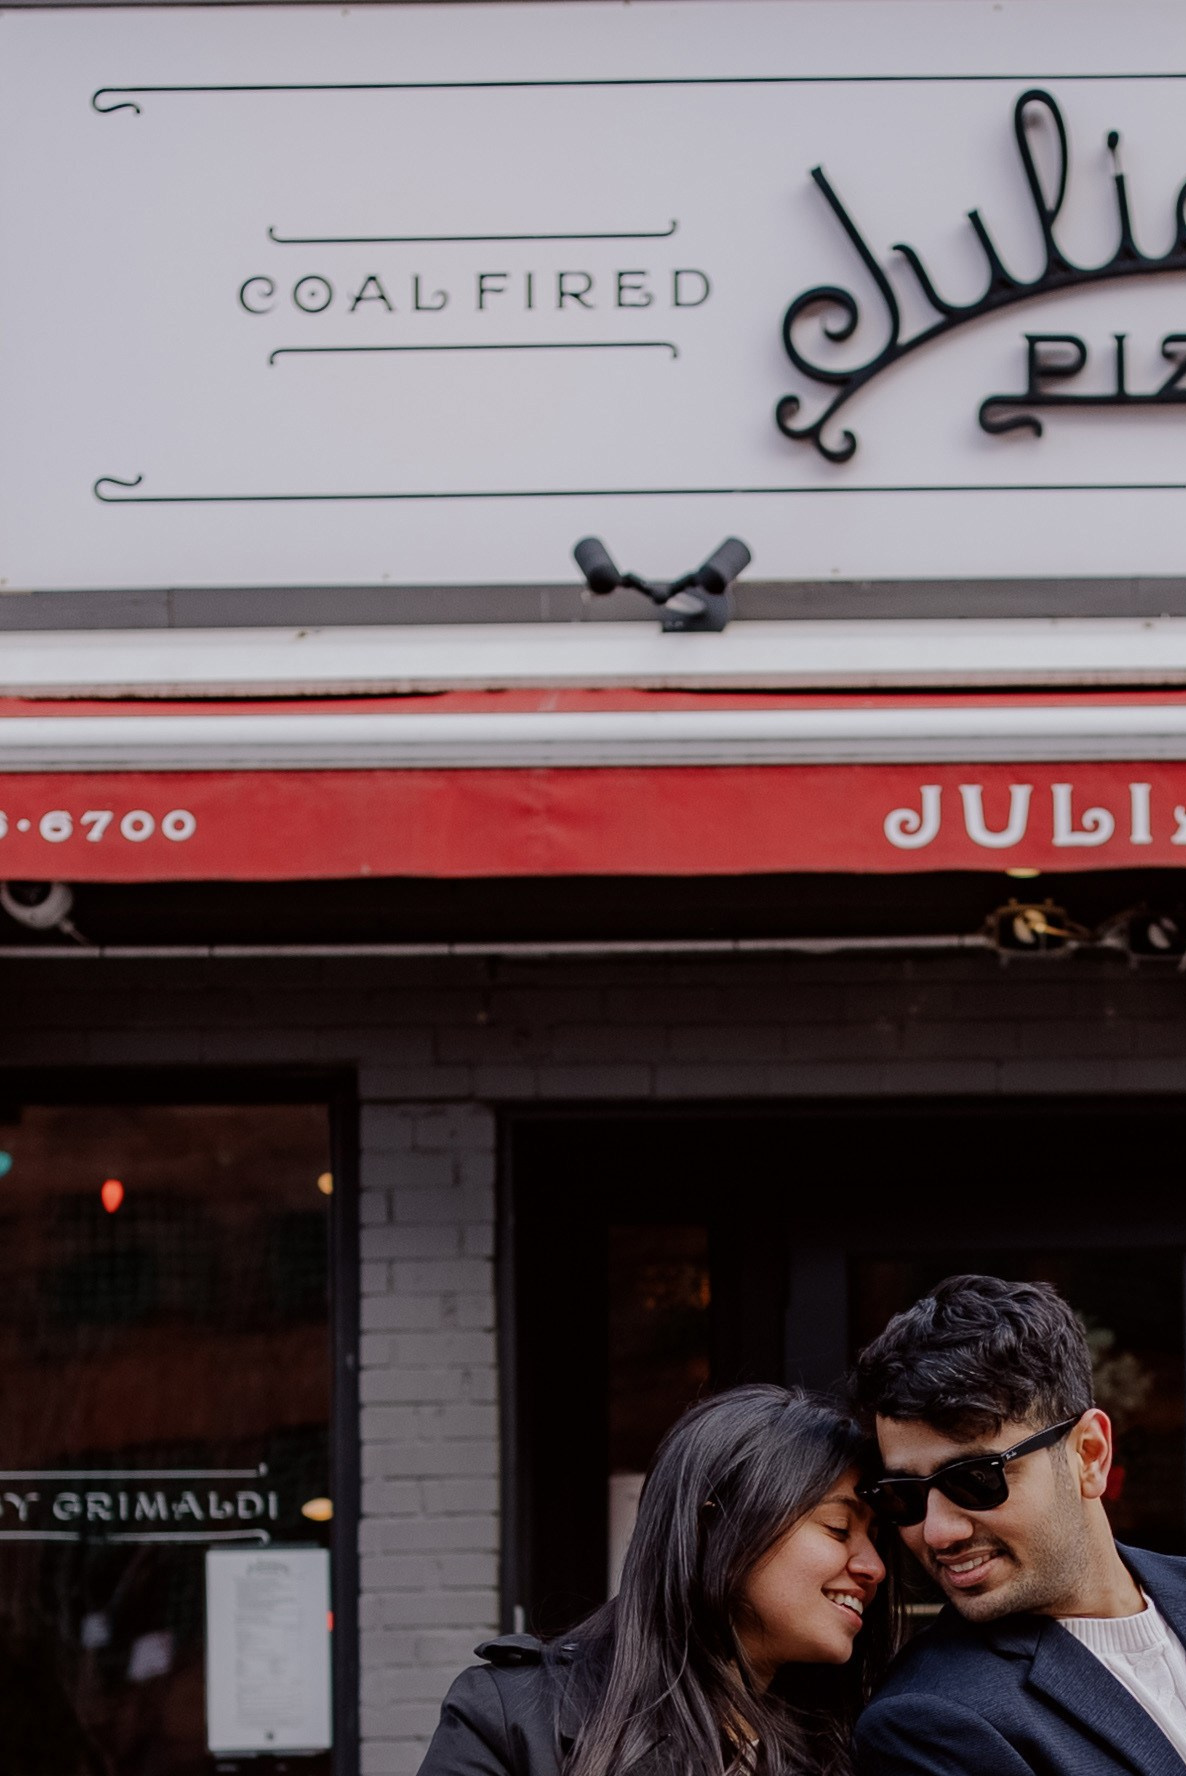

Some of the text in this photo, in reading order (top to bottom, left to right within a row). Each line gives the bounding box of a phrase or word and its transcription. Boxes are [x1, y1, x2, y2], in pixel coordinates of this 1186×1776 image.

[238, 269, 713, 314] COAL FIRED
[52, 1490, 279, 1522] GRIMALDI
